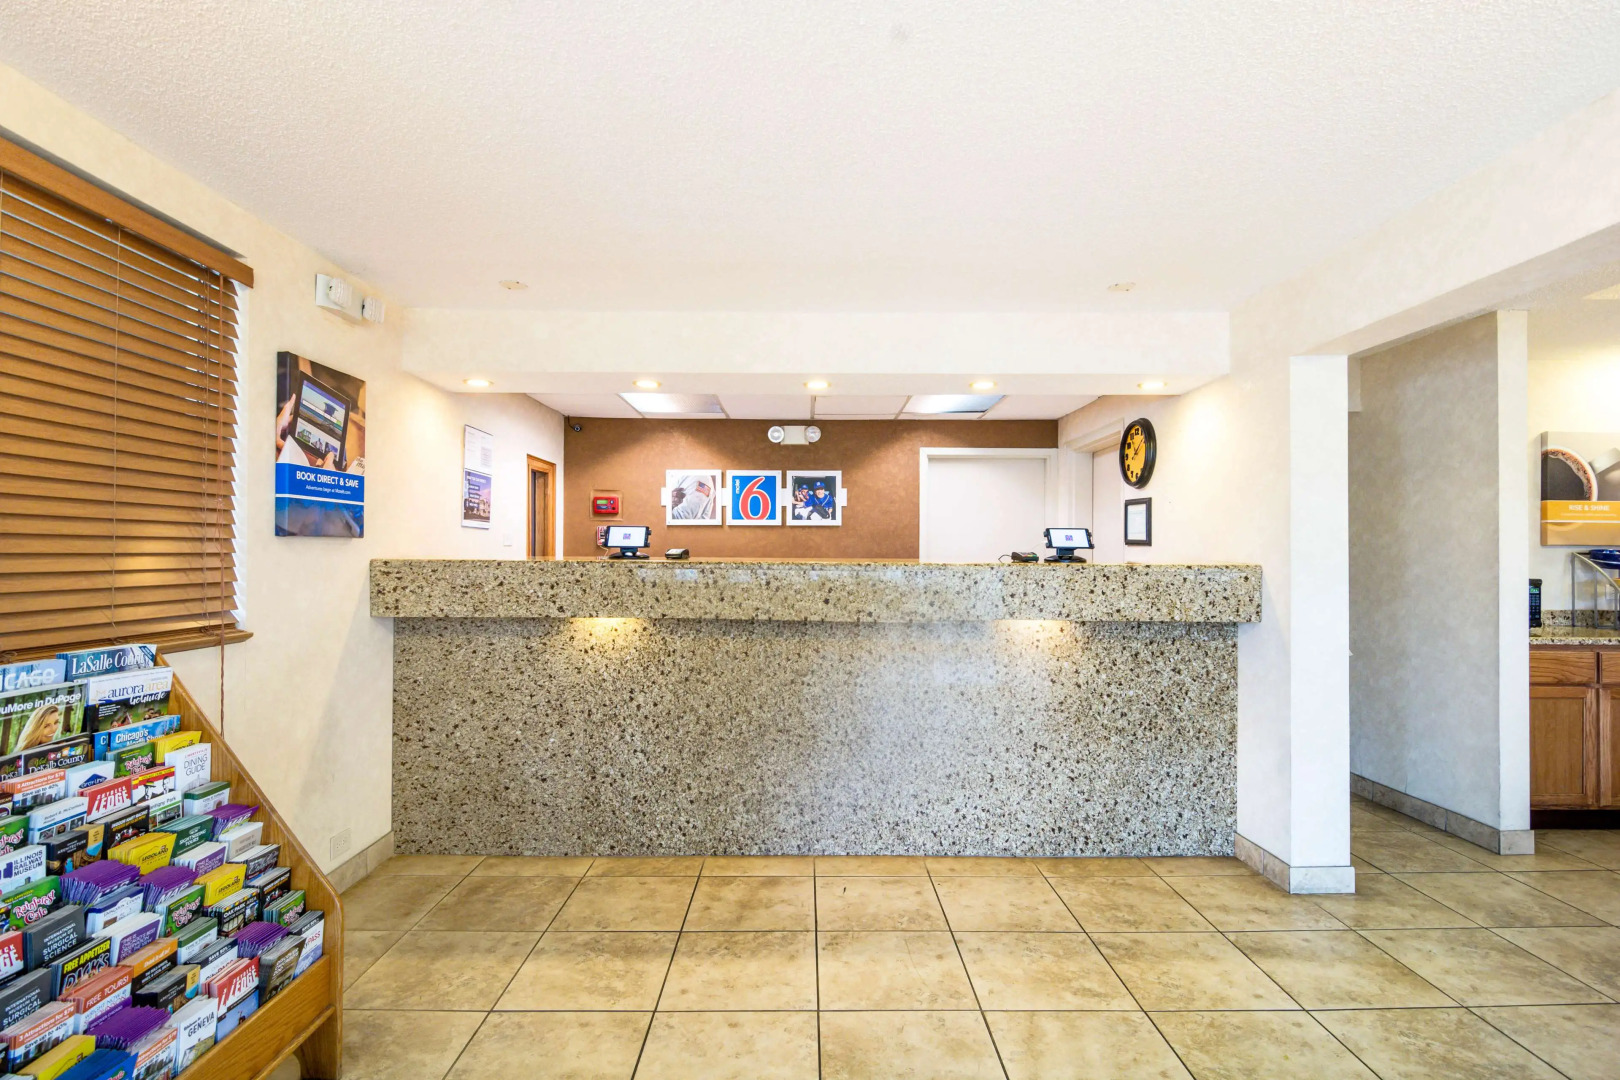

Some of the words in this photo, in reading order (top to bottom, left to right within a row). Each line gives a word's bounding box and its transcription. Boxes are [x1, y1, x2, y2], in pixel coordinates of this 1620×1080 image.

[296, 471, 316, 482] BOOK
[317, 474, 338, 485] DIRECT
[339, 478, 345, 486] &
[345, 478, 359, 488] SAVE
[738, 476, 772, 520] 6
[72, 654, 113, 676] LaSalle
[114, 650, 151, 671] County
[107, 684, 145, 699] aurora
[145, 680, 169, 693] area
[34, 697, 44, 707] in
[44, 692, 82, 706] DuPage
[115, 729, 149, 744] Chicago's
[29, 760, 57, 775] DeKalb
[57, 754, 86, 769] County
[183, 754, 208, 769] DINING
[185, 763, 206, 776] GUIDE
[57, 841, 86, 854] ARCHITECTURE
[142, 847, 169, 862] LEGOLAND
[13, 849, 43, 866] ILLINOIS
[13, 856, 43, 871] RAILWAY
[13, 862, 43, 877] MUSEUM
[12, 889, 56, 919] Rainforest
[235, 902, 246, 912] PARK
[24, 906, 48, 925] Cafe
[44, 923, 77, 943] INTERNATIONAL
[47, 931, 68, 946] MUSEUM
[43, 932, 78, 956] SURGICAL
[44, 939, 77, 962] SCIENCE
[63, 957, 79, 974] FREE
[78, 939, 111, 966] APPETIZER
[5, 988, 41, 1012] INTERNATIONAL
[86, 991, 102, 1008] FREE
[104, 975, 129, 996] TOURS!
[3, 998, 42, 1026] SURGICAL
[8, 999, 30, 1015] MUSEUM
[24, 1020, 55, 1039] Attractions
[187, 1011, 215, 1037] GENEVA
[24, 1040, 36, 1051] Save
[55, 1022, 67, 1031] 40%
